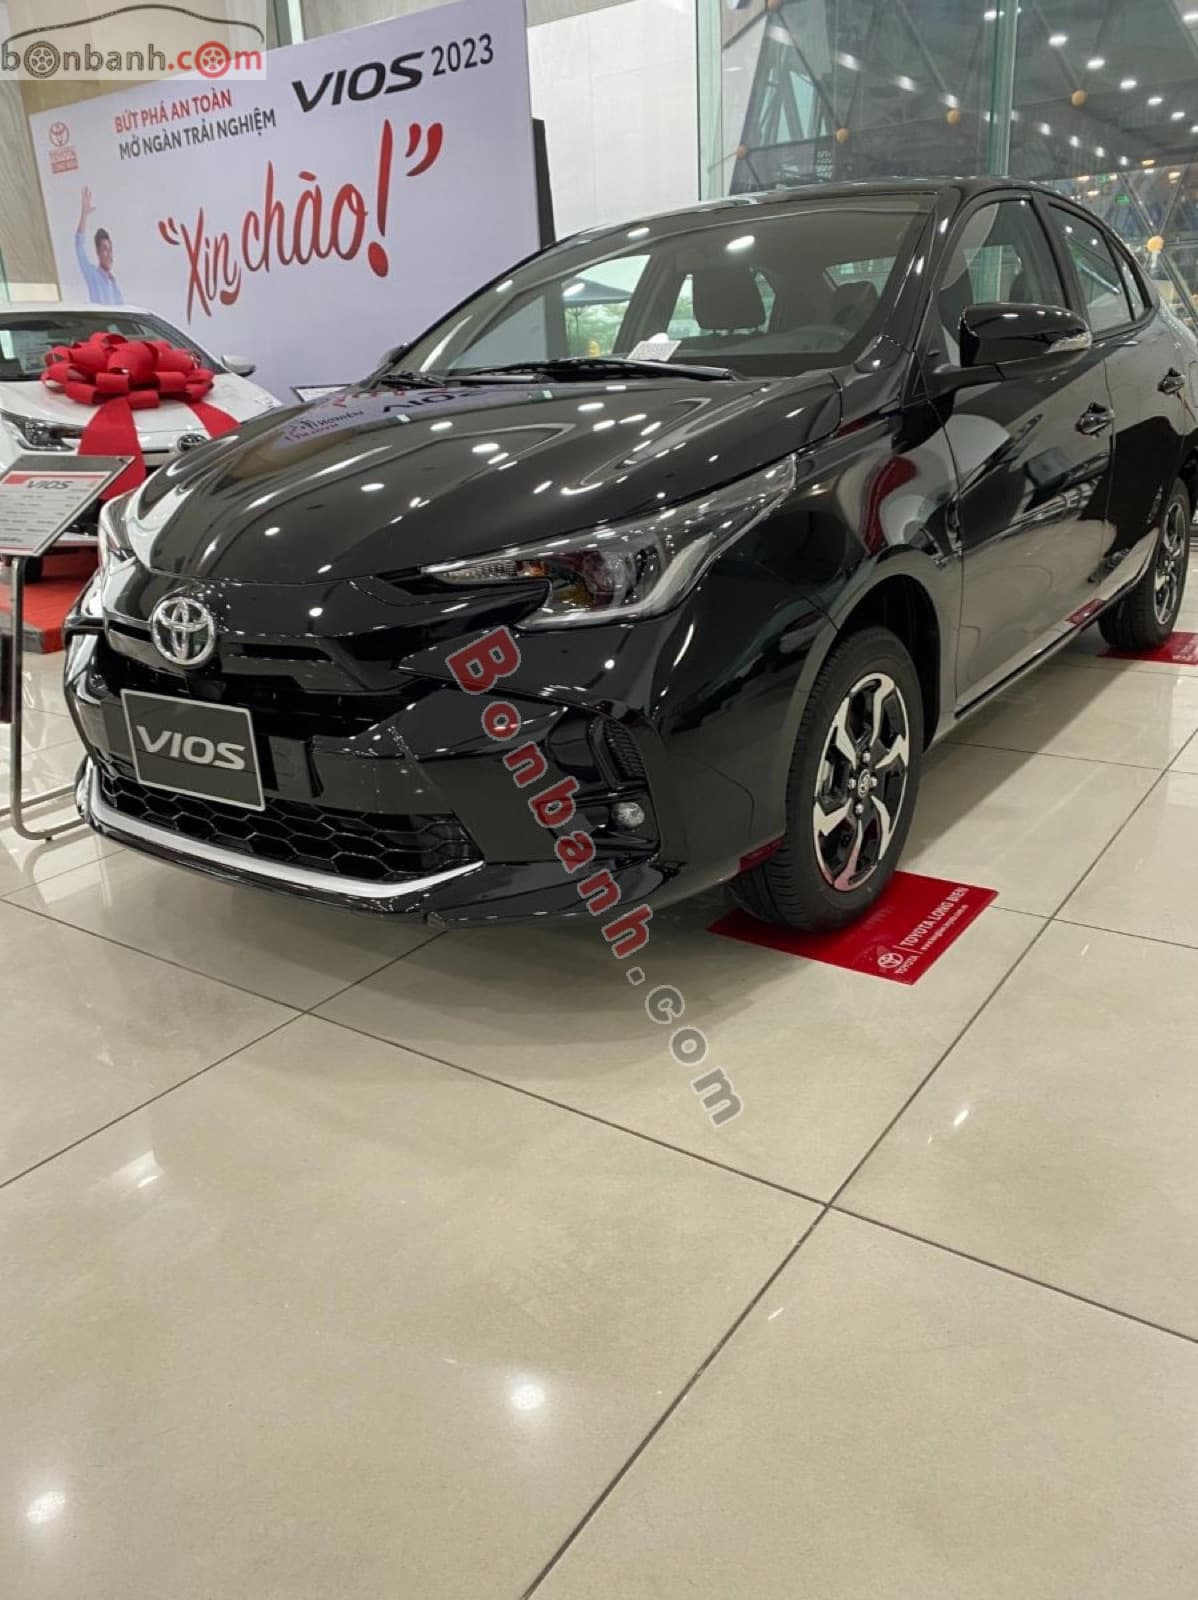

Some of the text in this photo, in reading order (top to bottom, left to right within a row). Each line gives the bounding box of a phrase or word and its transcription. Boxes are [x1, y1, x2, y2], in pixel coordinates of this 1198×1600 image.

[291, 33, 494, 112] VIOS 2023
[141, 100, 168, 127] PHÁ
[171, 99, 191, 121] AN
[192, 88, 233, 114] TOÀN
[142, 129, 182, 154] NGÀN
[216, 107, 277, 137] NGHIỆM
[27, 481, 72, 489] VIOS
[136, 725, 246, 770] VIOS
[900, 921, 936, 946] TOYOTA
